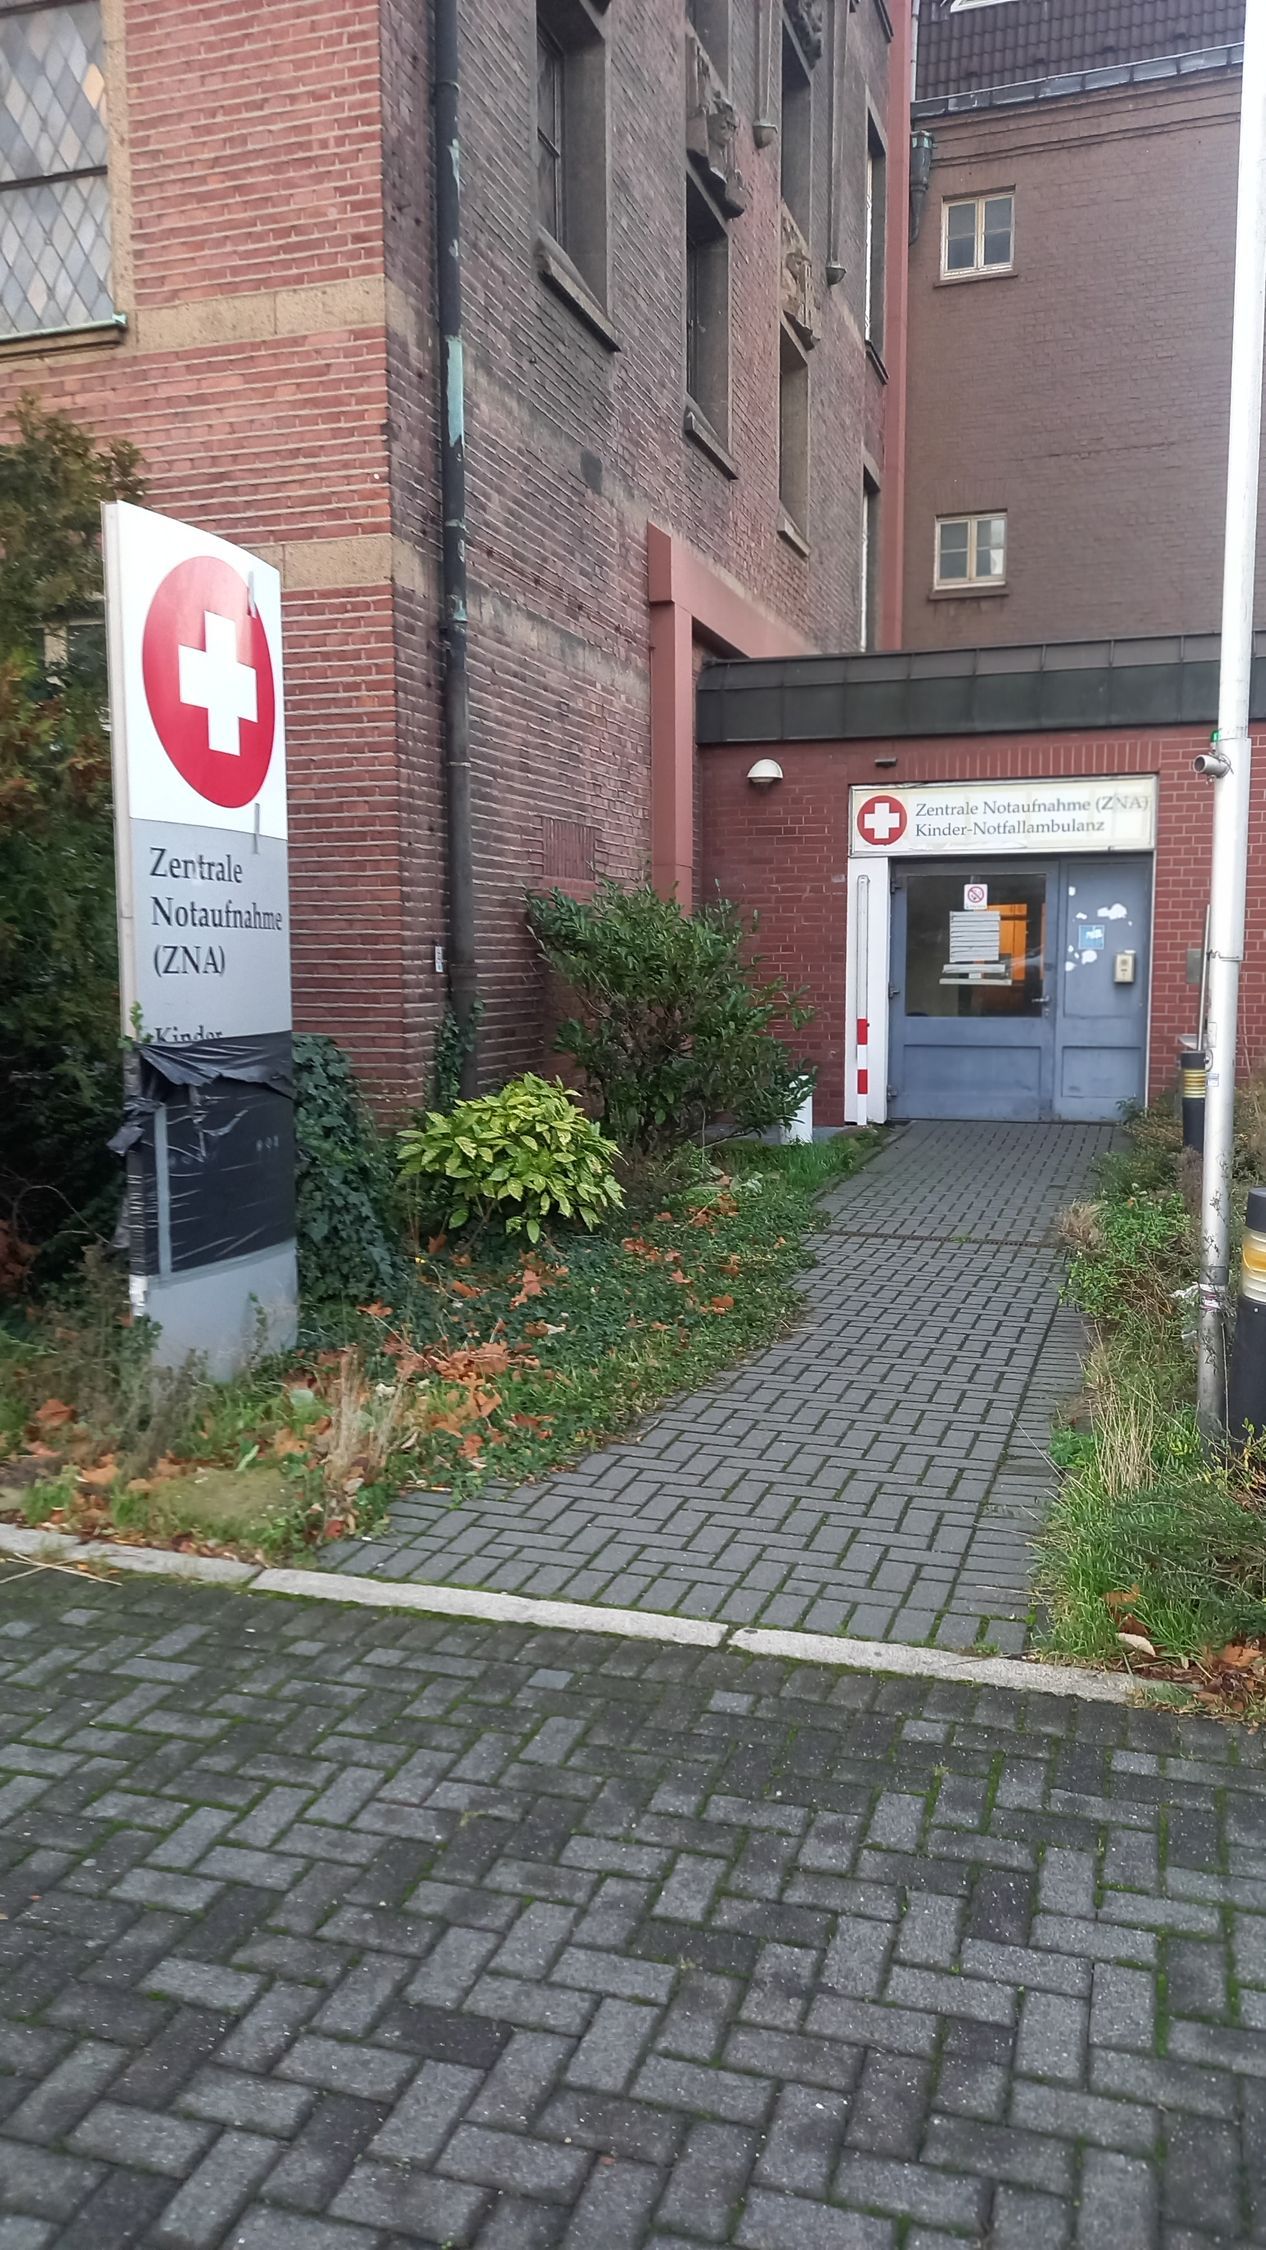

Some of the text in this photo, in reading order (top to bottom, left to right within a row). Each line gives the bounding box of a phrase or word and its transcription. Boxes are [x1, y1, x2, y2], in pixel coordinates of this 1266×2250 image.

[915, 793, 1150, 817] Zentrale Notaufnahme (ZNA)
[915, 818, 1105, 838] Kinder-Notfallambulanz
[149, 846, 243, 884] Zentrale
[151, 896, 283, 931] Notaufnahme
[154, 944, 226, 978] (ZNA)
